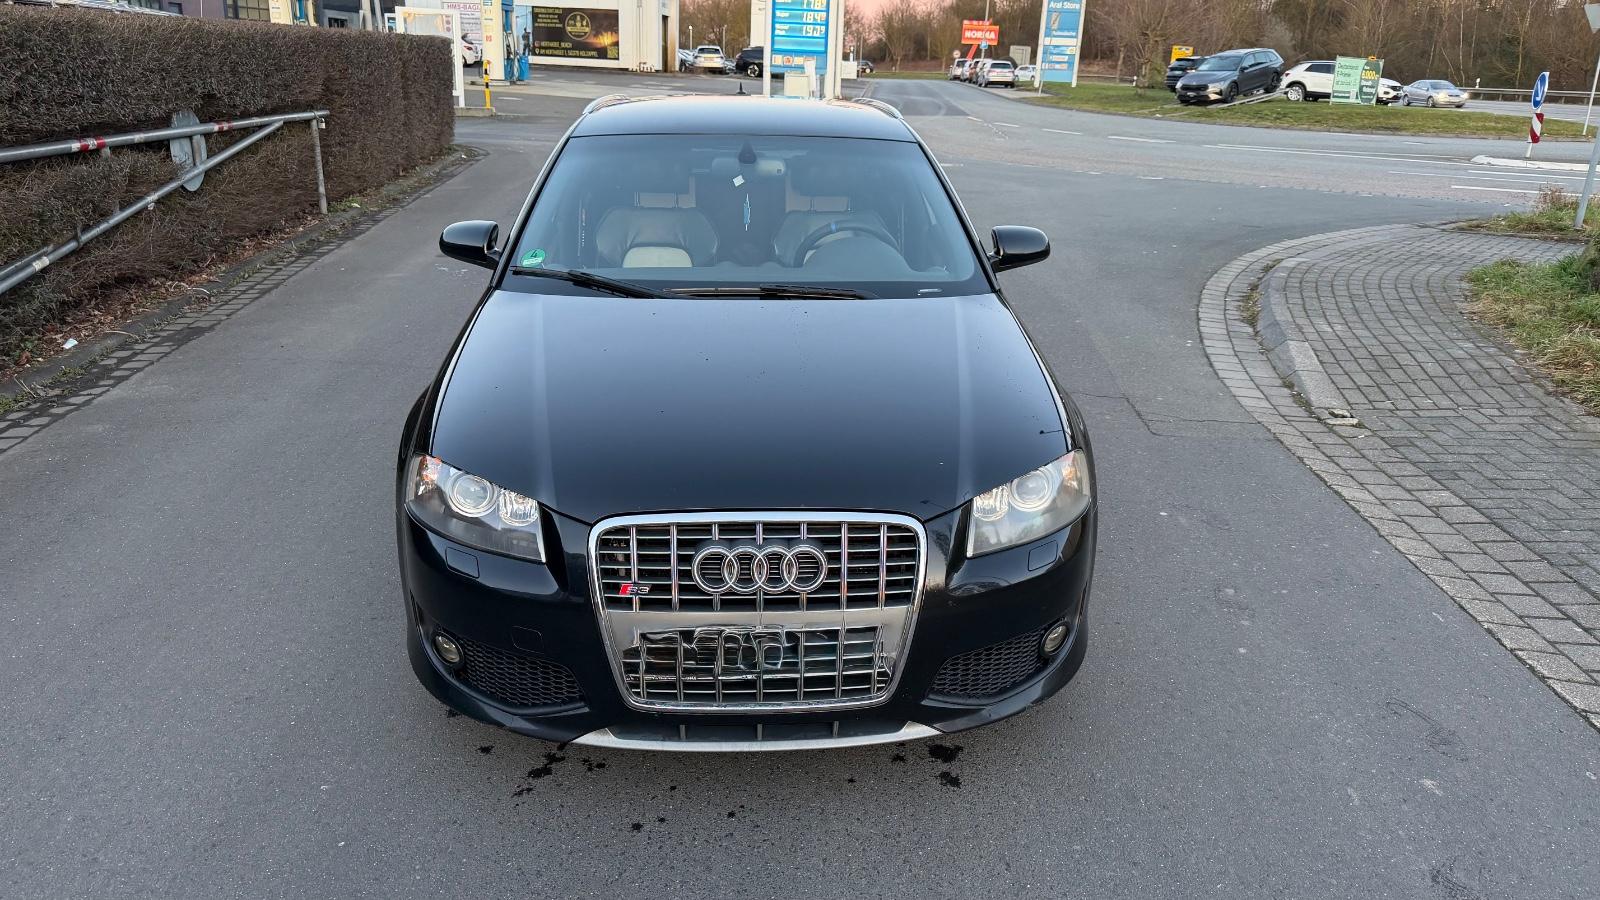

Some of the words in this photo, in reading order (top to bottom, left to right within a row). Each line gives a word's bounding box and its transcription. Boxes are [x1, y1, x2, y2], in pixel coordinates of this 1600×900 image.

[1049, 1, 1062, 9] Aral
[1063, 1, 1080, 9] Store
[965, 30, 995, 39] NORMA
